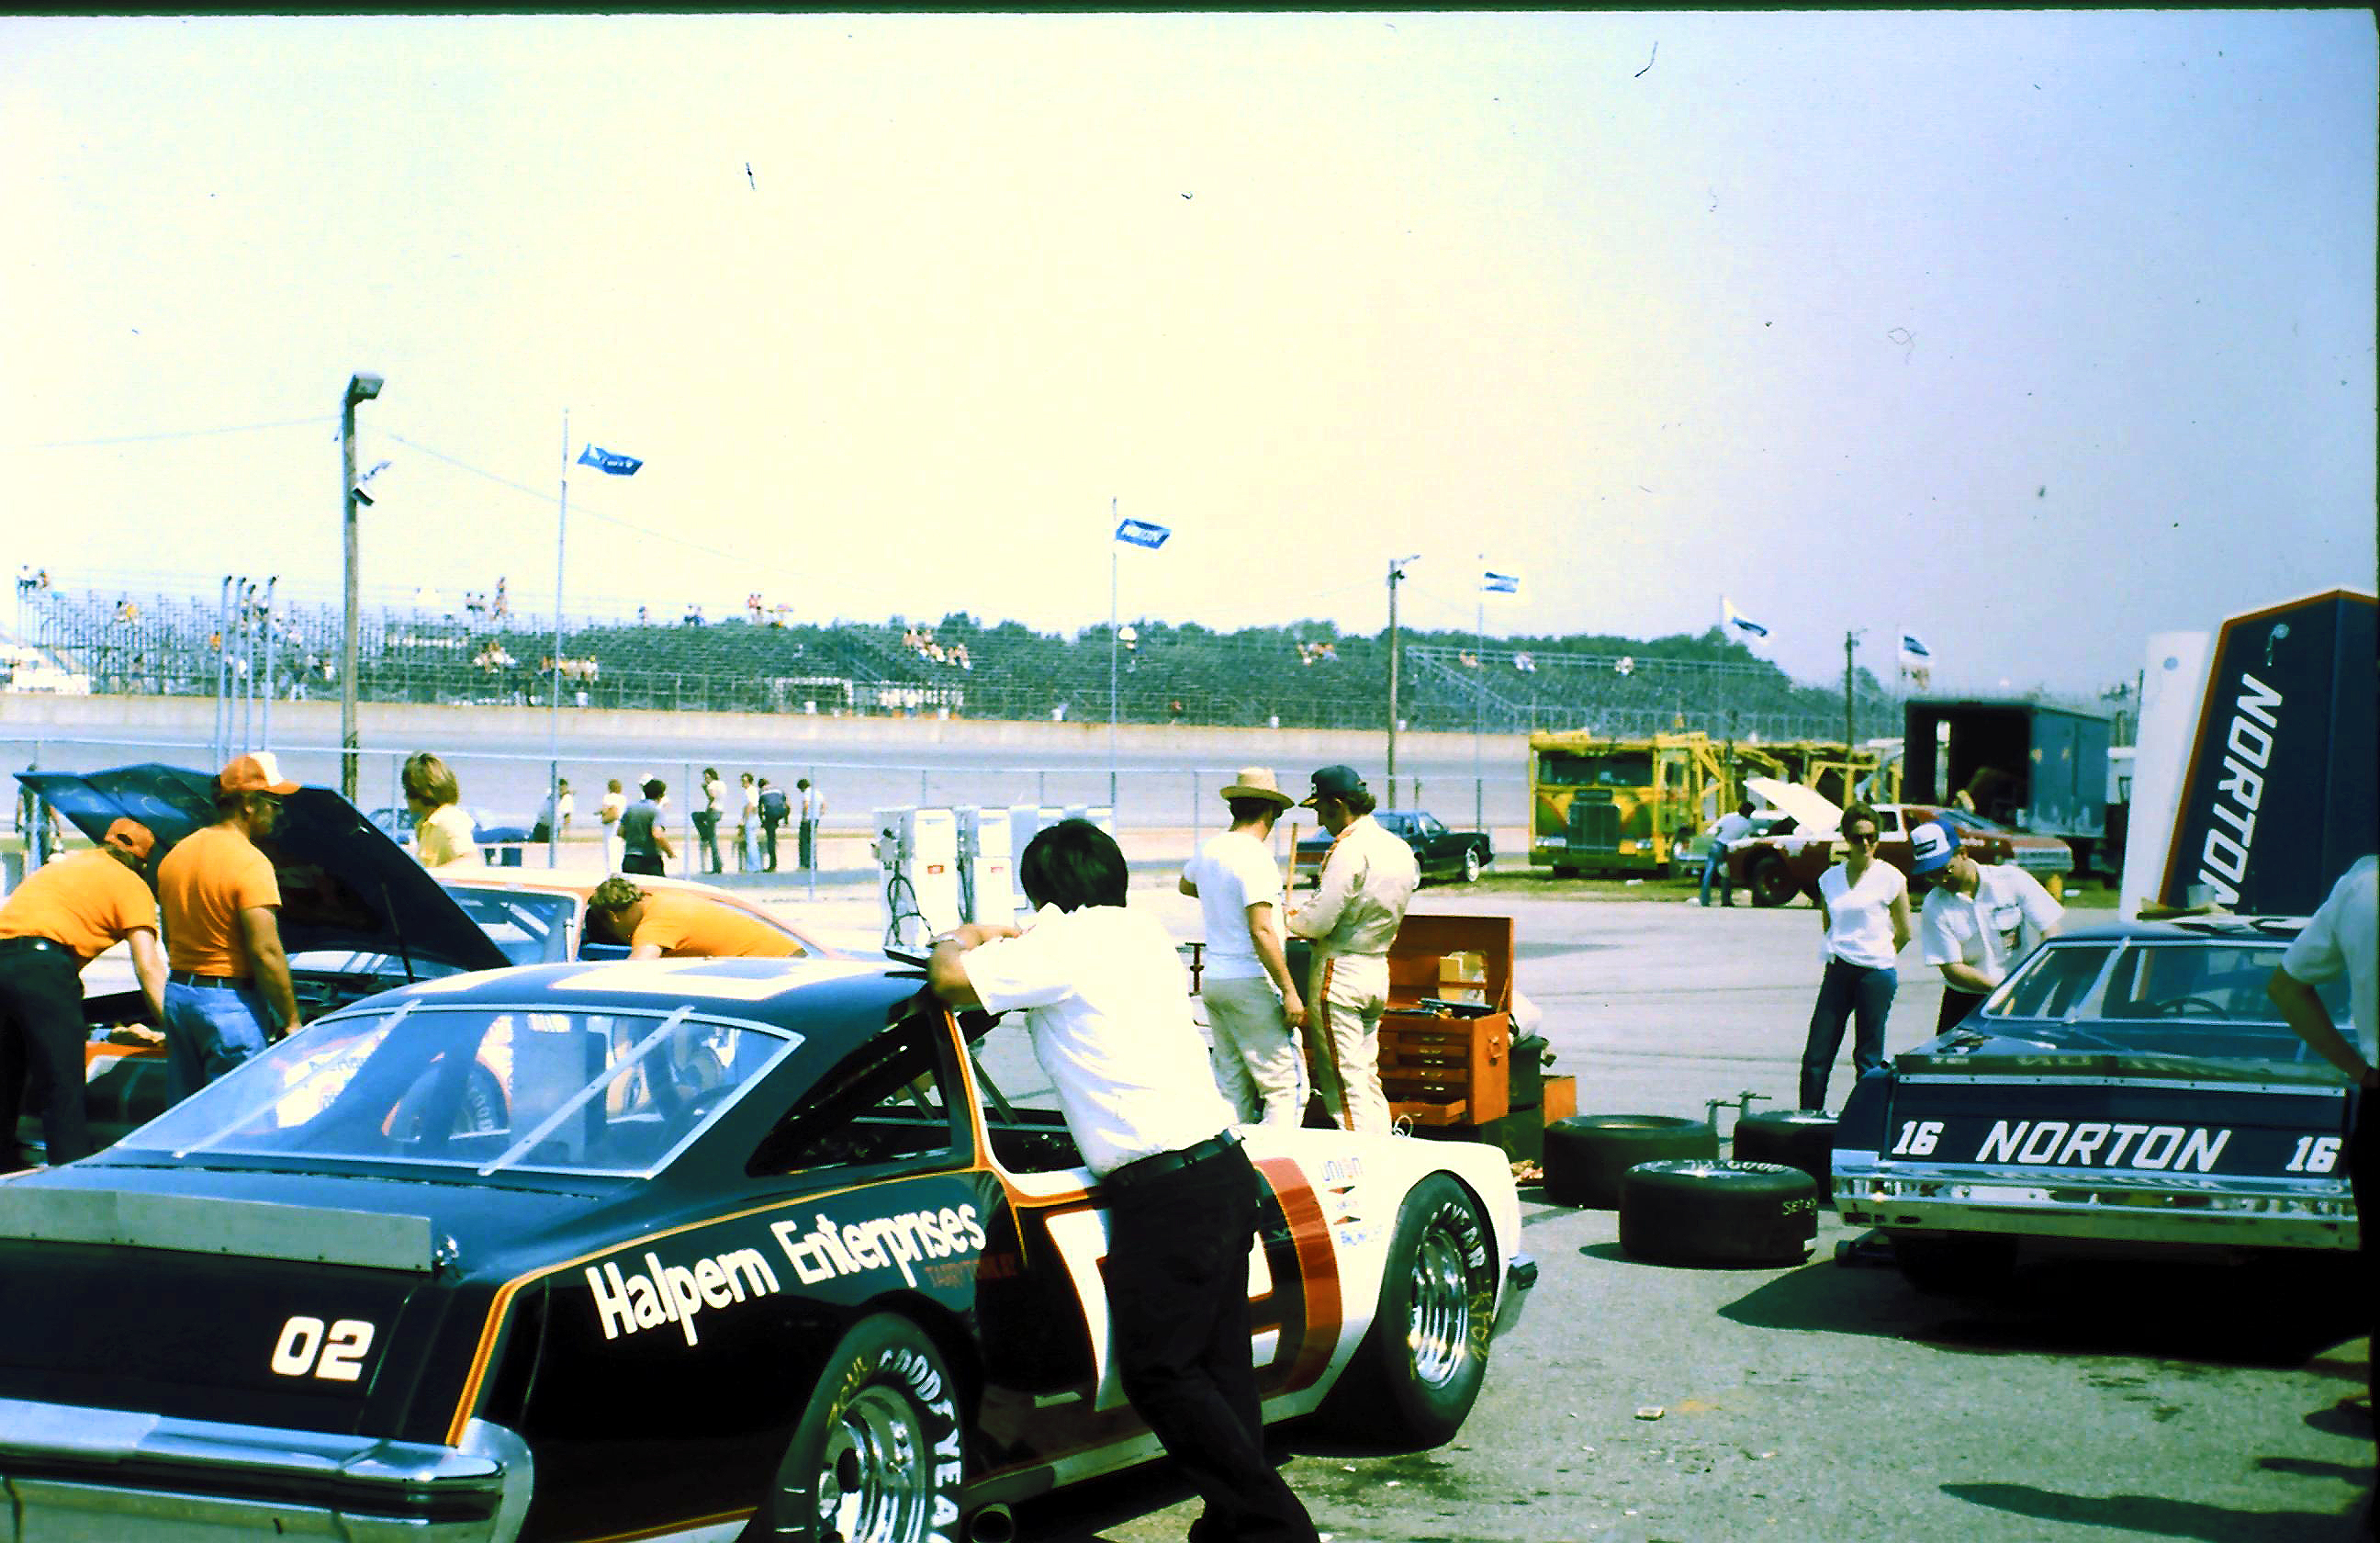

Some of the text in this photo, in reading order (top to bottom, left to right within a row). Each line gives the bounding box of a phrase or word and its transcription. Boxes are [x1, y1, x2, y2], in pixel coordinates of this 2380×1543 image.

[1892, 1120, 1945, 1155] 16
[1975, 1120, 2232, 1173] NORTON
[2285, 1135, 2342, 1173] 16
[585, 1203, 986, 1346] Halpern Enterprises
[271, 1315, 376, 1381] 02
